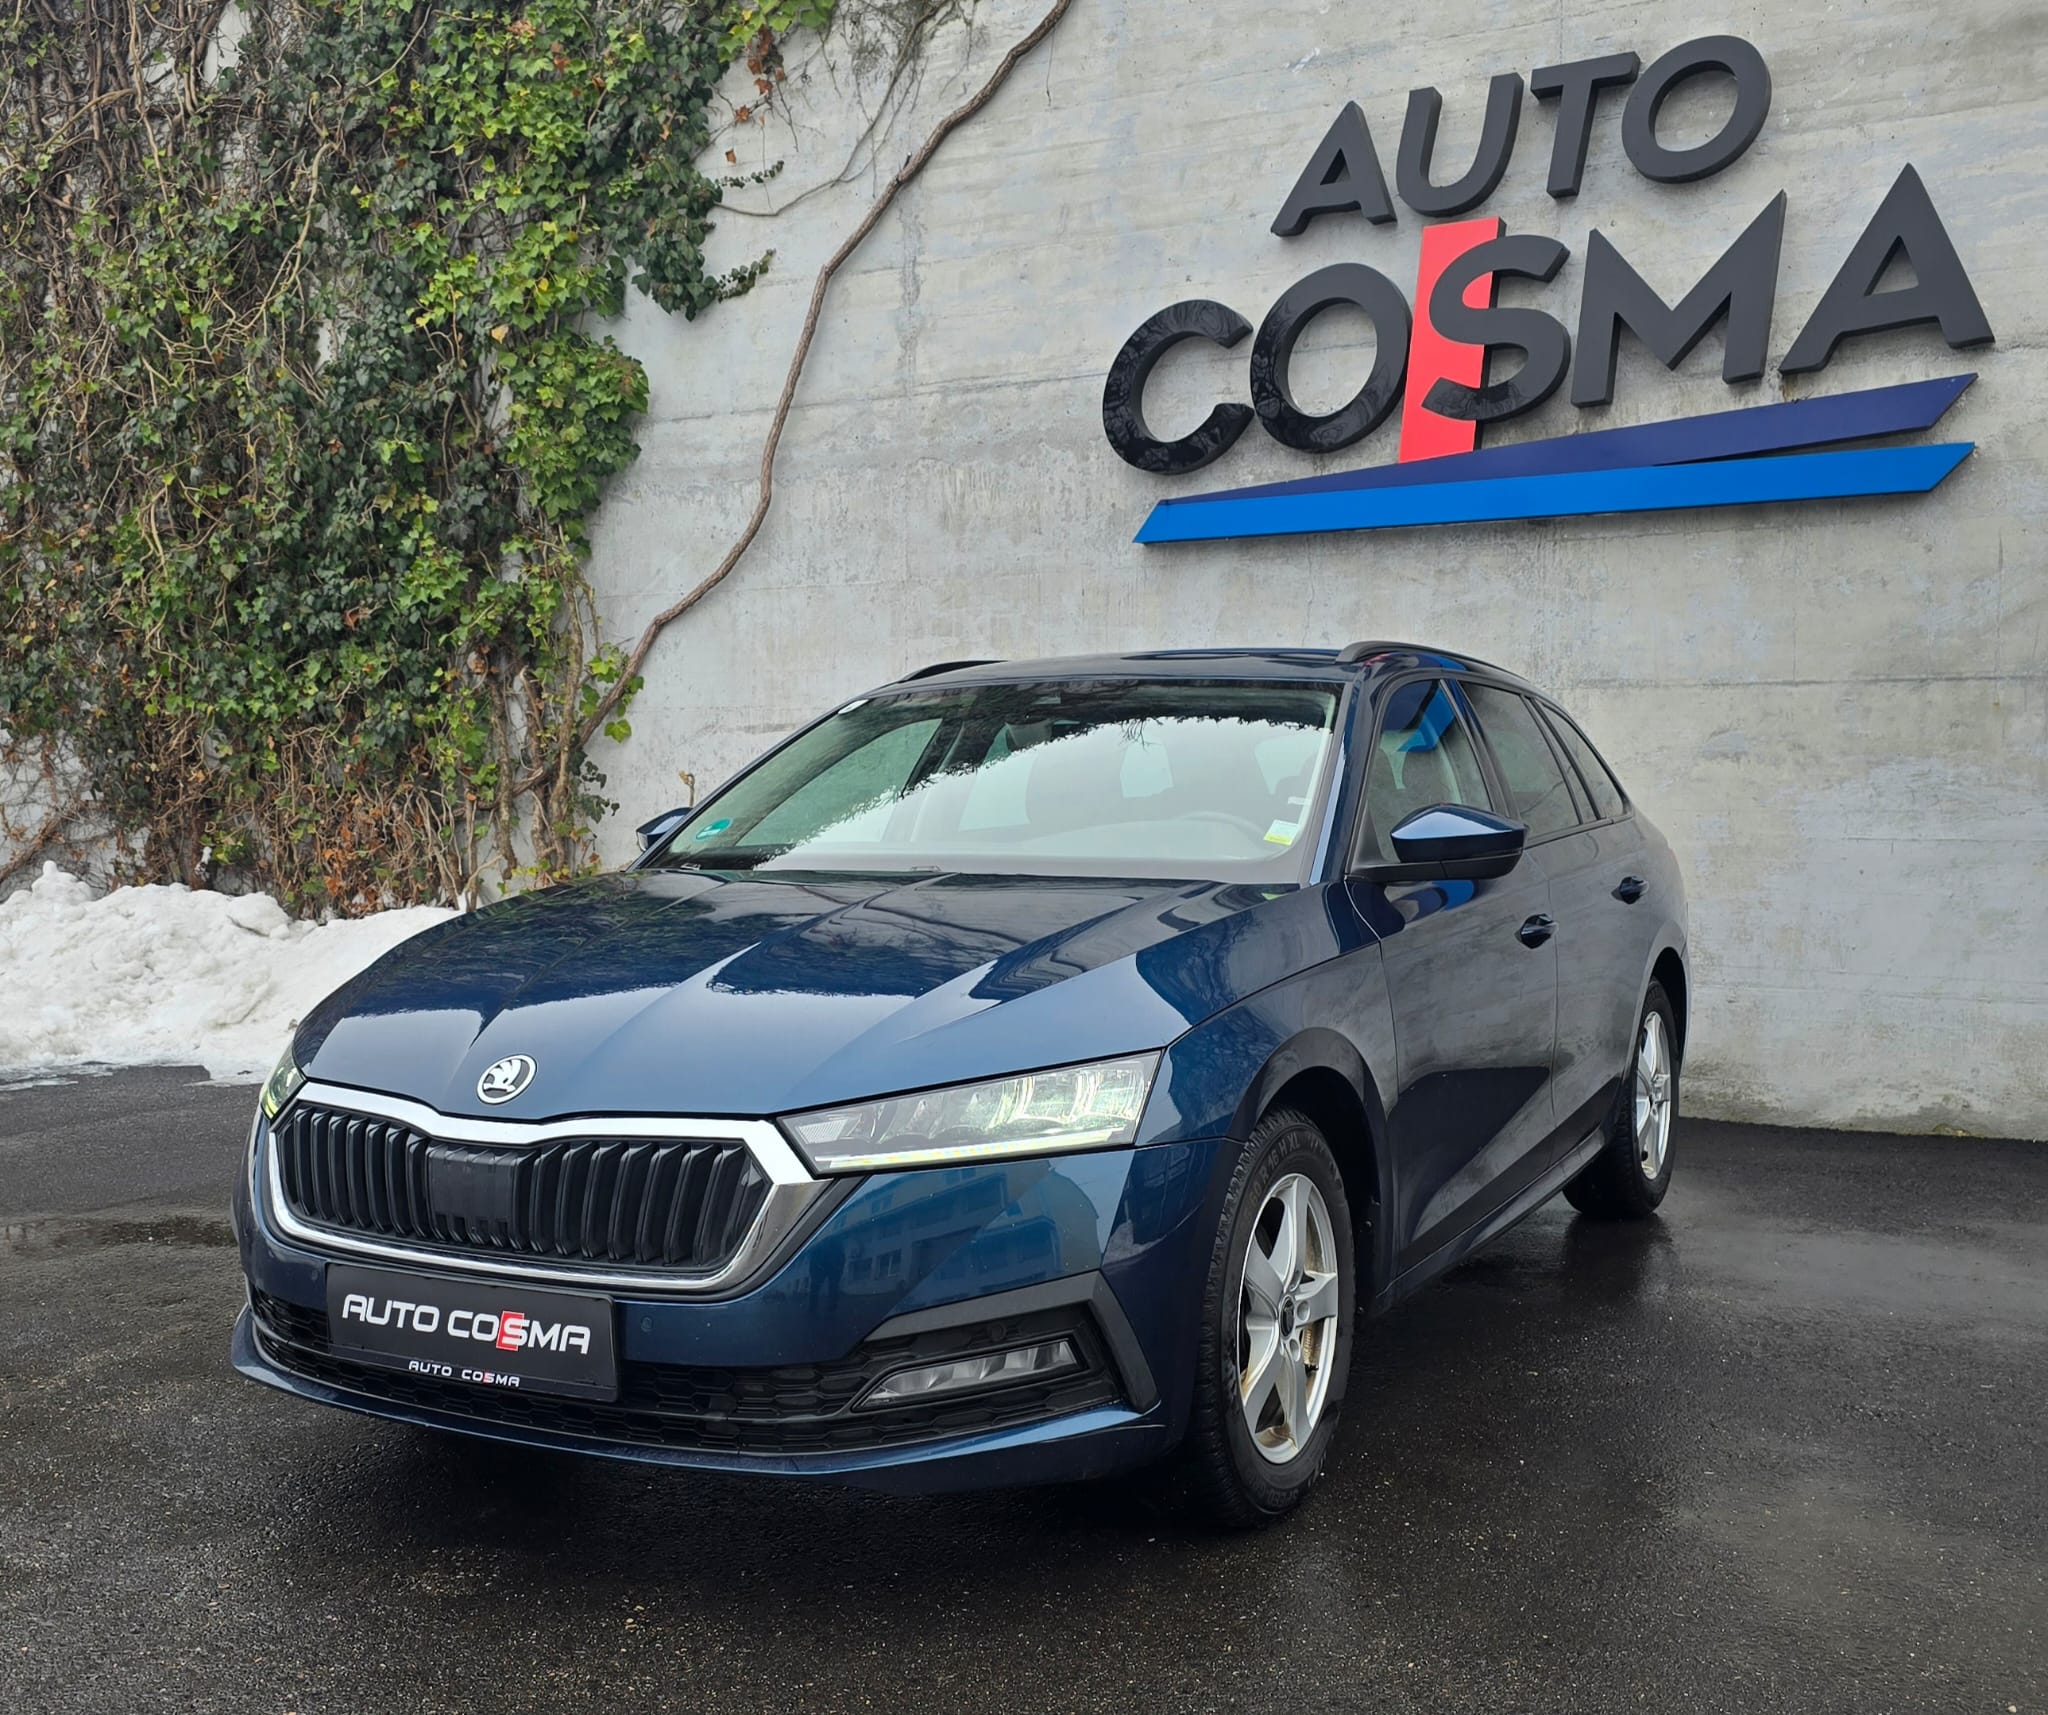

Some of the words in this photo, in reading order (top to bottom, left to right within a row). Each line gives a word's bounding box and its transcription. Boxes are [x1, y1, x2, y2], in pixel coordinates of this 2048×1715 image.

[1271, 35, 1771, 237] AUTO
[1103, 163, 1994, 475] COSMA
[342, 1294, 439, 1332] AUTO
[448, 1310, 591, 1354] COSMA
[409, 1361, 452, 1377] AUTO
[461, 1370, 520, 1387] COSMA
